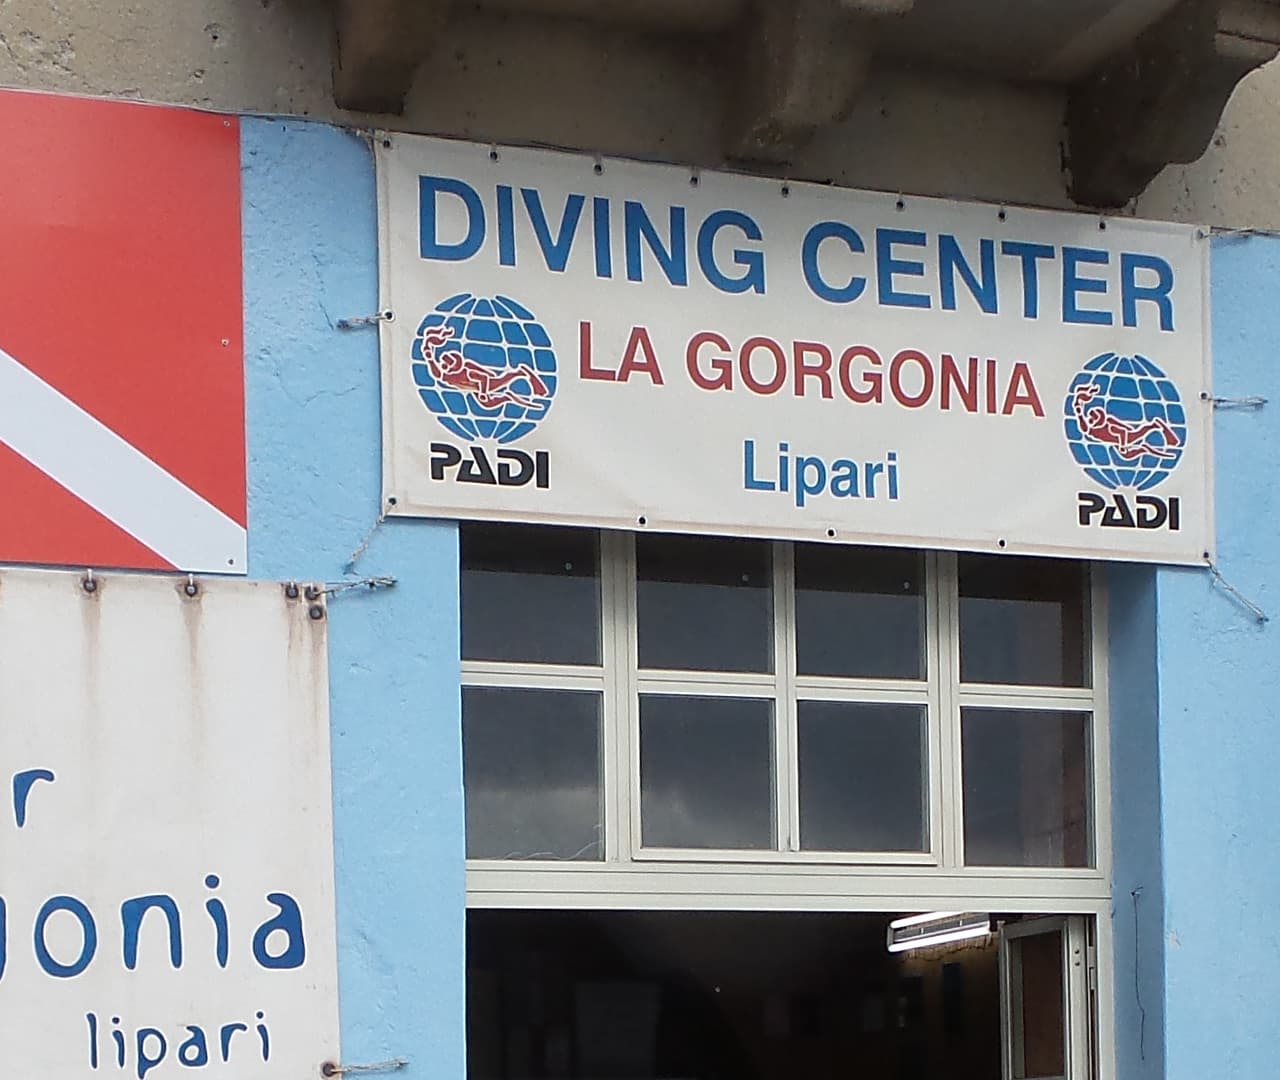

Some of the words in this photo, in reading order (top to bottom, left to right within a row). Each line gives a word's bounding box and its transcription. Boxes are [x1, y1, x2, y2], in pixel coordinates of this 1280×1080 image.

[418, 174, 767, 296] DIVING
[801, 220, 1176, 333] CENTER
[578, 321, 664, 386] LA
[686, 332, 1046, 418] GORGONIA
[429, 442, 550, 489] PADI
[743, 438, 899, 507] Lipari
[1077, 492, 1180, 531] PADI
[86, 1009, 271, 1079] lipari
